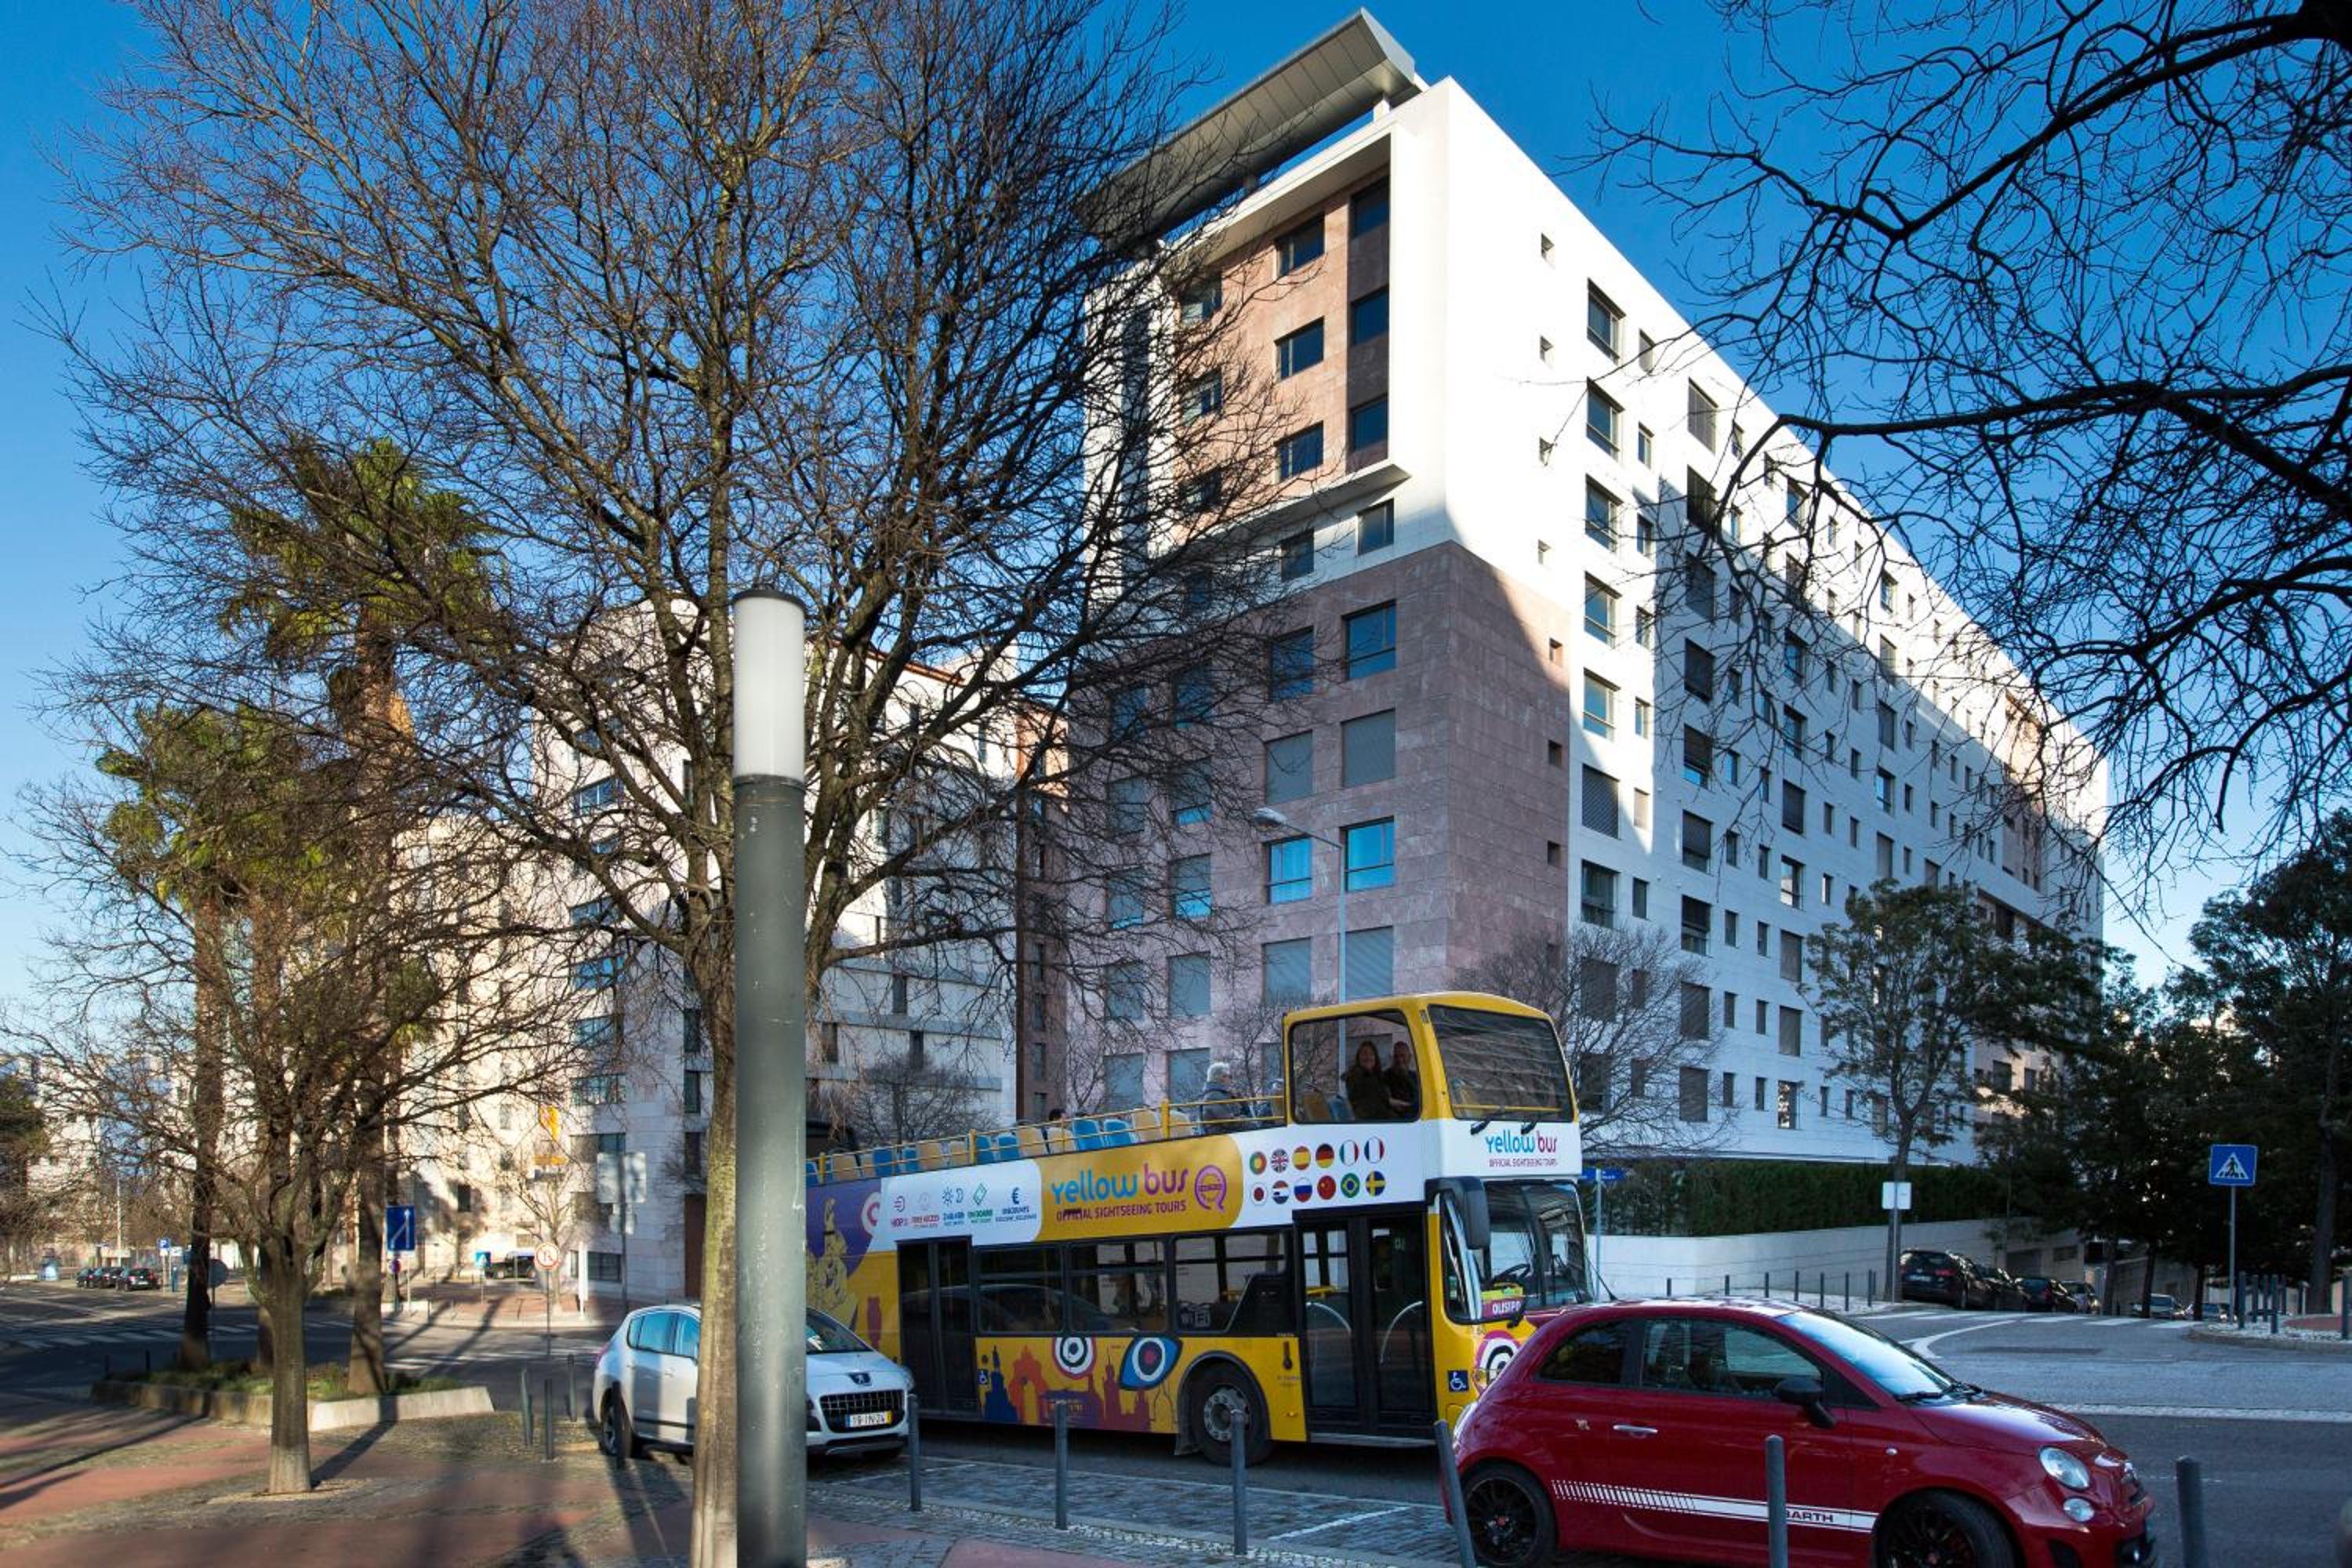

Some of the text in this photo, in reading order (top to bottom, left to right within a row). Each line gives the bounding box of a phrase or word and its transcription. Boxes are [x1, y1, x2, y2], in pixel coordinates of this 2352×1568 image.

[1485, 1129, 1557, 1153] yellow bus
[1051, 1162, 1189, 1204] yellow bus
[1056, 1200, 1187, 1221] OFFICIAL SIGHTSEEING TOURS
[1785, 1510, 1834, 1523] BARTH
